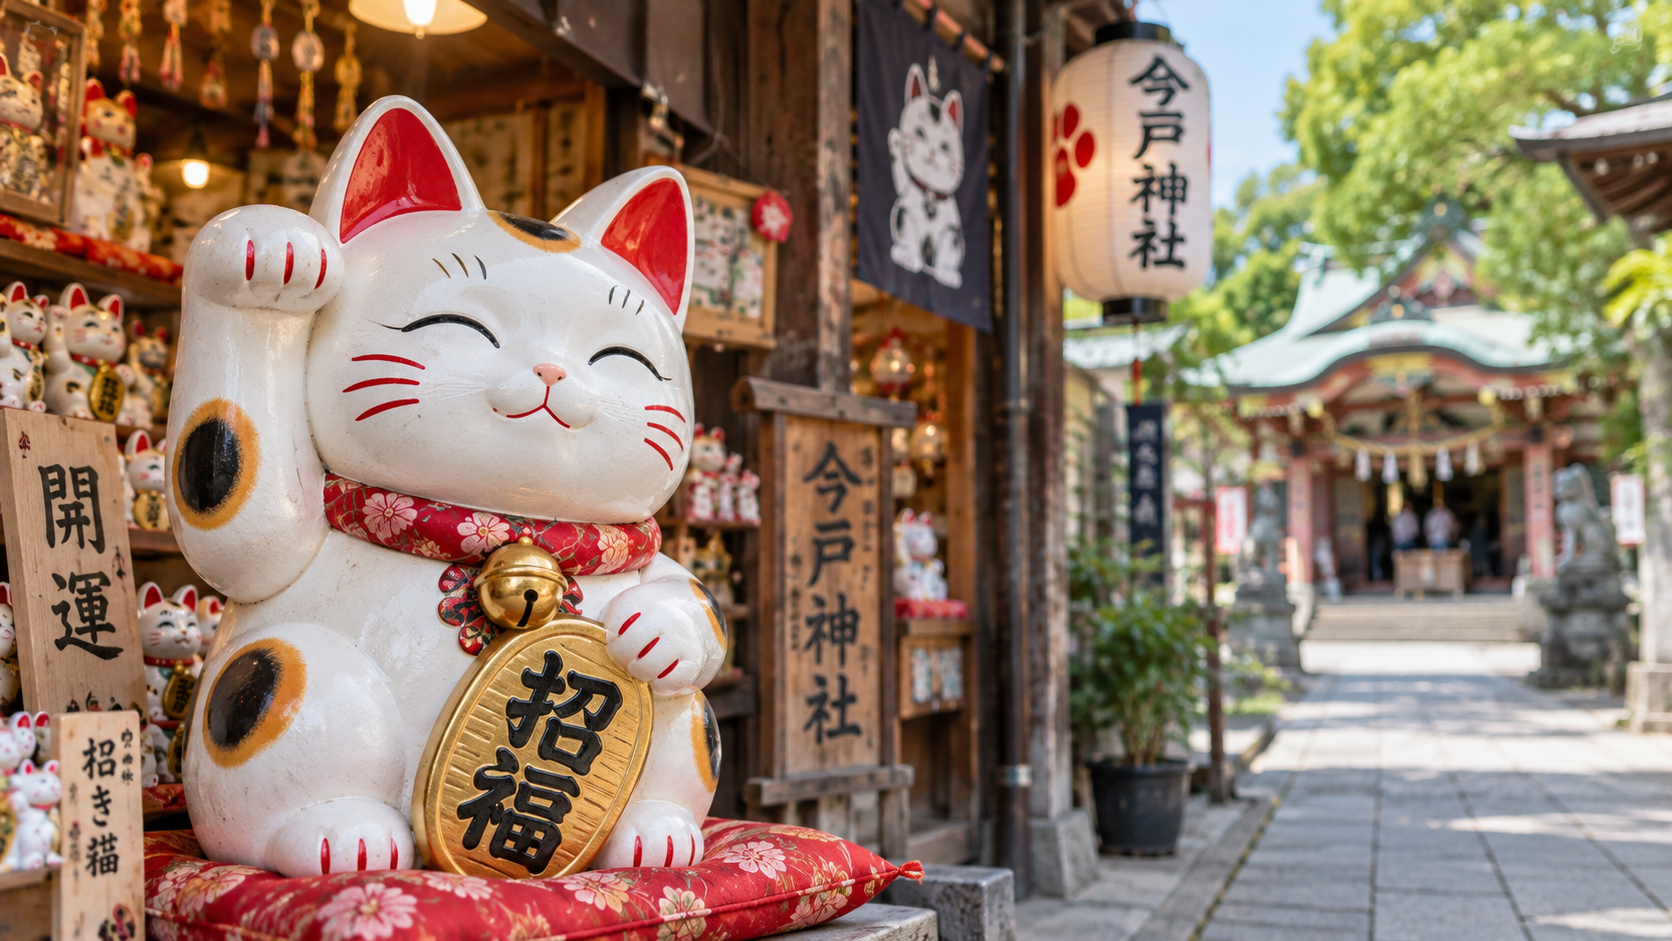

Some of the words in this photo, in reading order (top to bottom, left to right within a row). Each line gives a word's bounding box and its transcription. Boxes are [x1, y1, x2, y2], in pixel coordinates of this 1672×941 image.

[1129, 53, 1189, 269] 今戸神社
[38, 463, 125, 661] 開運
[803, 441, 863, 745] 今戸神社
[456, 650, 624, 875] 招福
